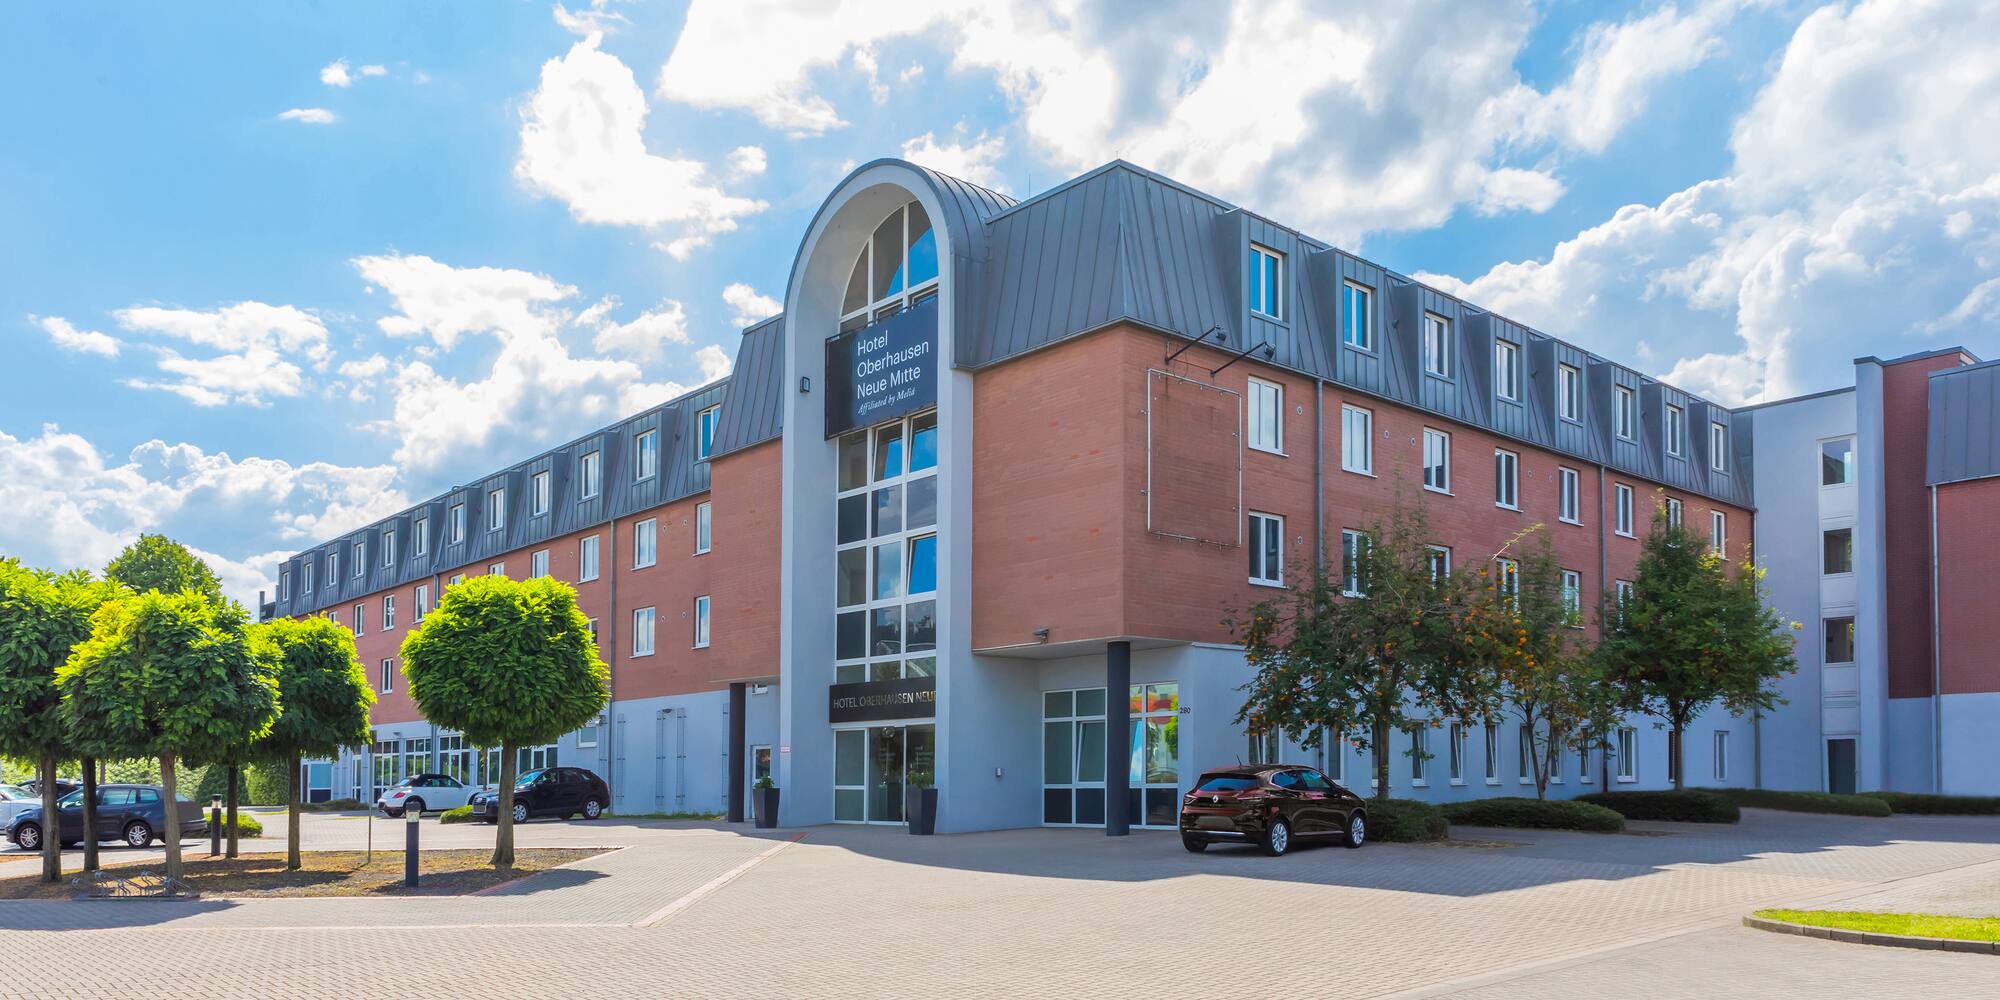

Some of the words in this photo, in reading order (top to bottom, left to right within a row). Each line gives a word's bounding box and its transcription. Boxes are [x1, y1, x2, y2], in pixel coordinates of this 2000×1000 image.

[857, 330, 888, 357] Hotel
[857, 341, 929, 378] Oberhausen
[857, 378, 887, 400] Neue
[890, 366, 921, 388] Mitte
[857, 395, 888, 415] Affiliated
[888, 394, 896, 407] by
[833, 697, 858, 709] HOTEL
[859, 692, 914, 707] OBERHAUSEN
